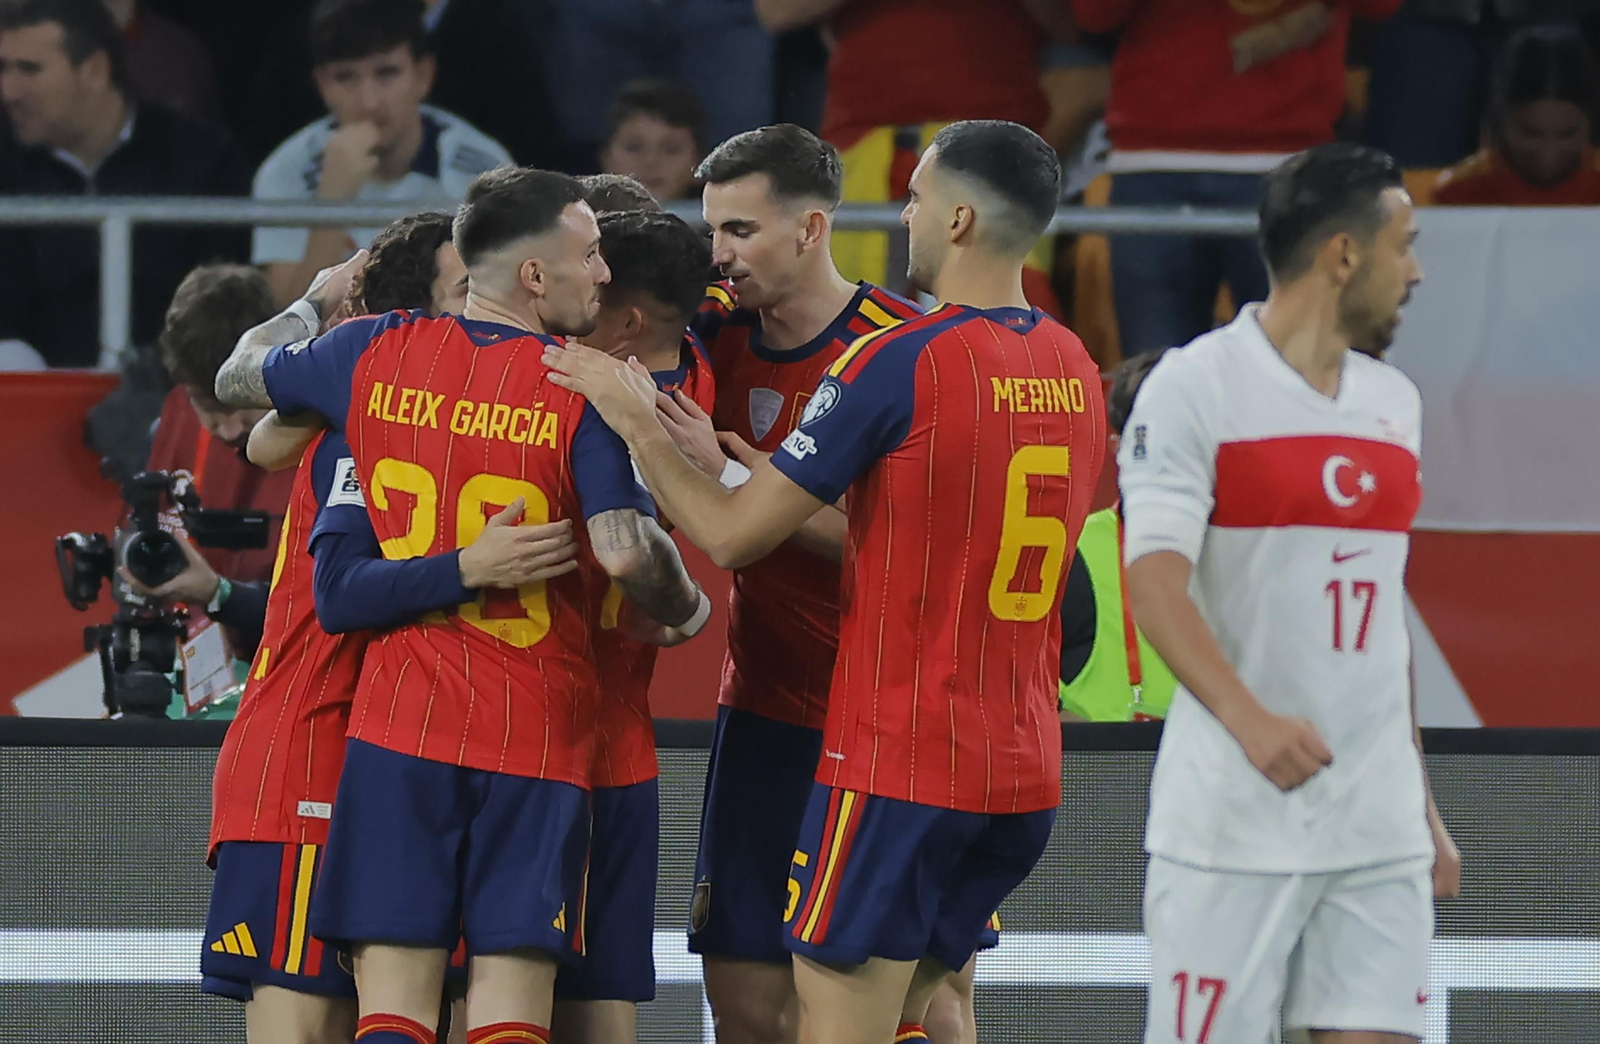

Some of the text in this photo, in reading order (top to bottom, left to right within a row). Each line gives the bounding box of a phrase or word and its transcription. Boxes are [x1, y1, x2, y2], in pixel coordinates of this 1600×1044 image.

[367, 381, 558, 449] ALEIX GARCÍA
[990, 376, 1085, 413] MERINO
[988, 445, 1068, 622] 6
[1325, 579, 1377, 652] 17
[1172, 971, 1227, 1044] 17
